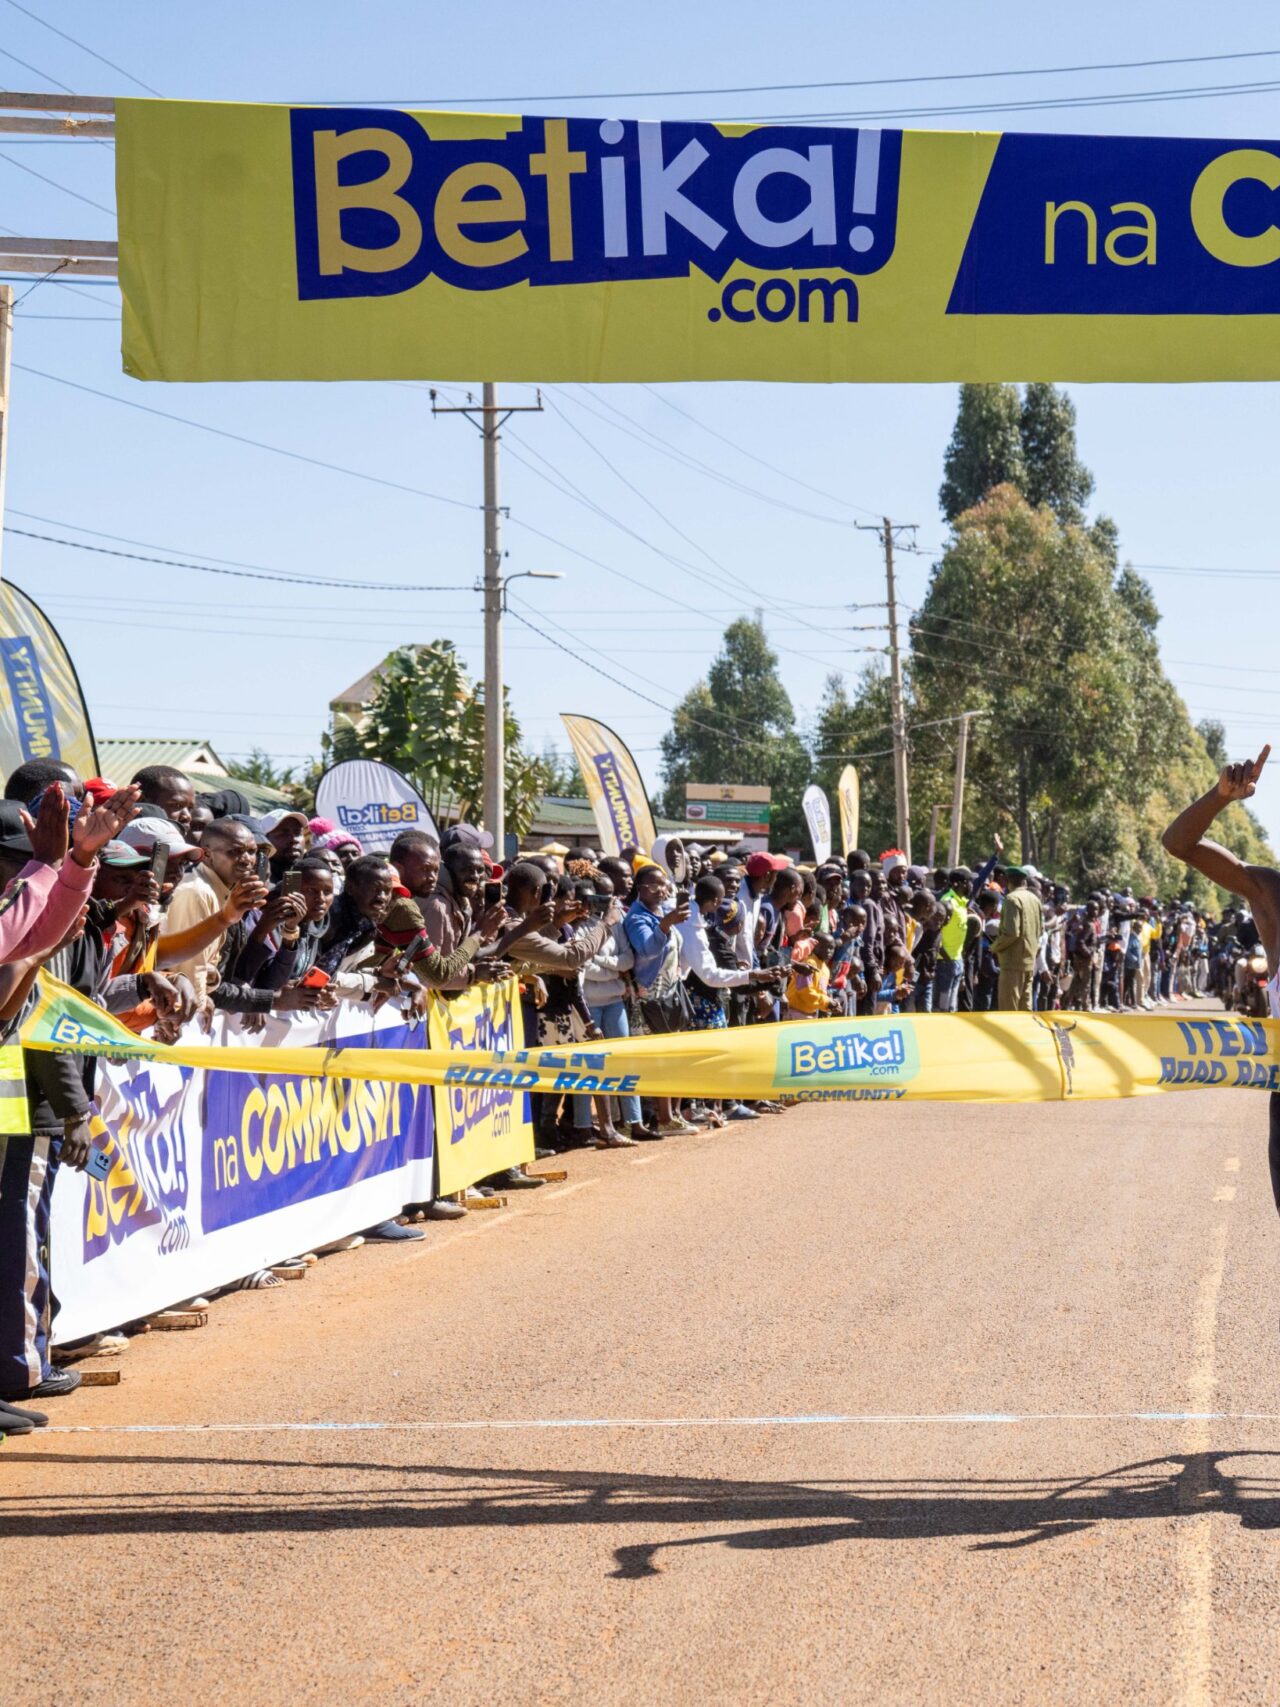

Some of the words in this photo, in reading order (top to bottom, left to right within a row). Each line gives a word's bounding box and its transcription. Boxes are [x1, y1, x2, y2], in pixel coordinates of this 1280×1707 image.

[311, 117, 882, 276] Betika!
[1044, 200, 1158, 265] na
[707, 277, 860, 324] .com
[795, 1034, 902, 1073] Betika!
[1177, 1019, 1270, 1057] ITEN
[444, 1062, 540, 1090] ROAD
[552, 1071, 641, 1093] RACE
[869, 1065, 900, 1076] .com
[1157, 1057, 1228, 1085] ROAD
[214, 1134, 240, 1190] na
